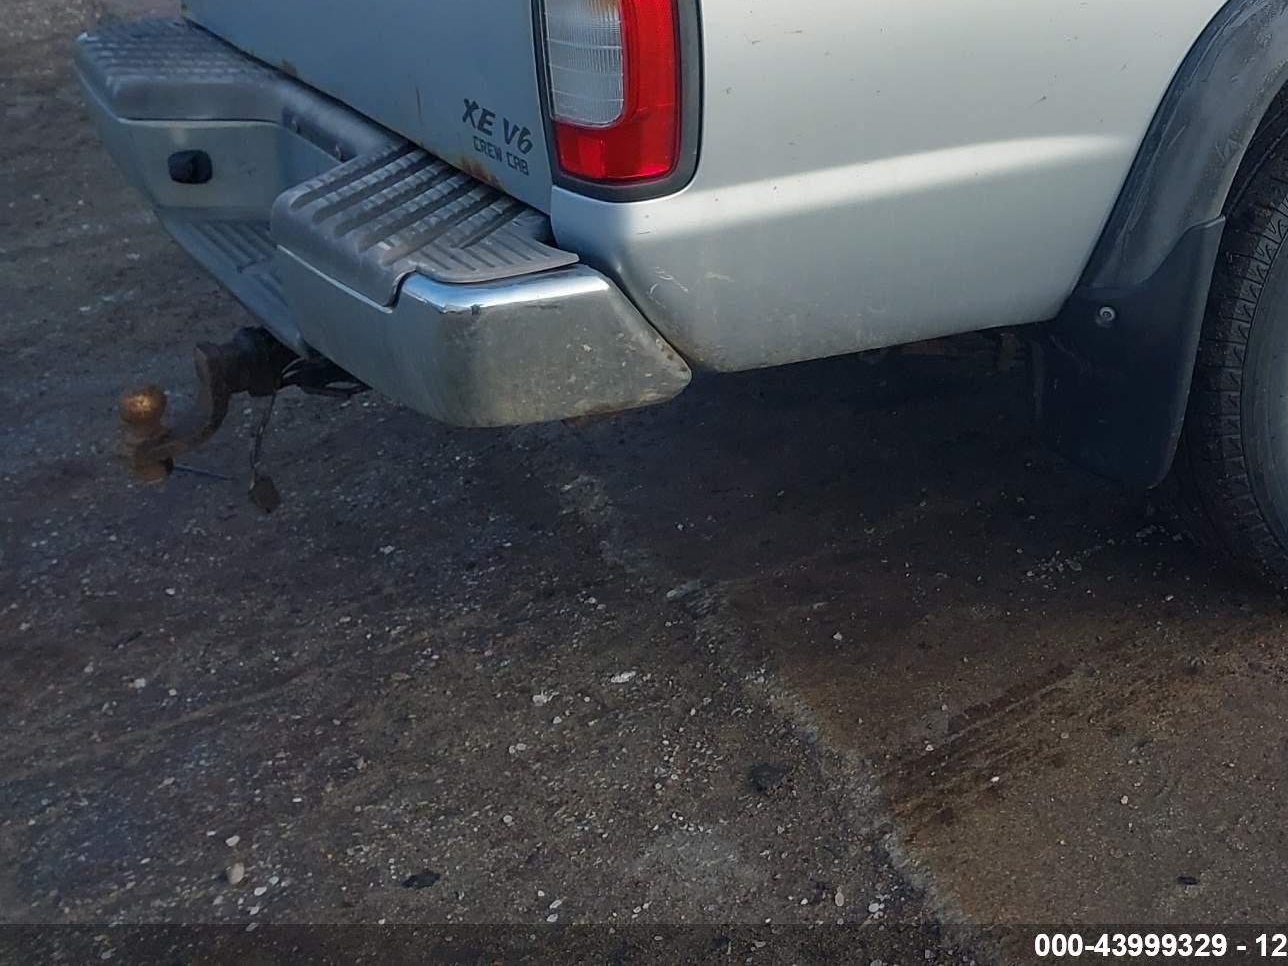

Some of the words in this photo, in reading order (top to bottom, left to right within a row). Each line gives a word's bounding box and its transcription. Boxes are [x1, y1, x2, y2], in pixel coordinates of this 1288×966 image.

[462, 98, 496, 136] XE
[503, 117, 534, 155] V6
[506, 152, 530, 176] CAB
